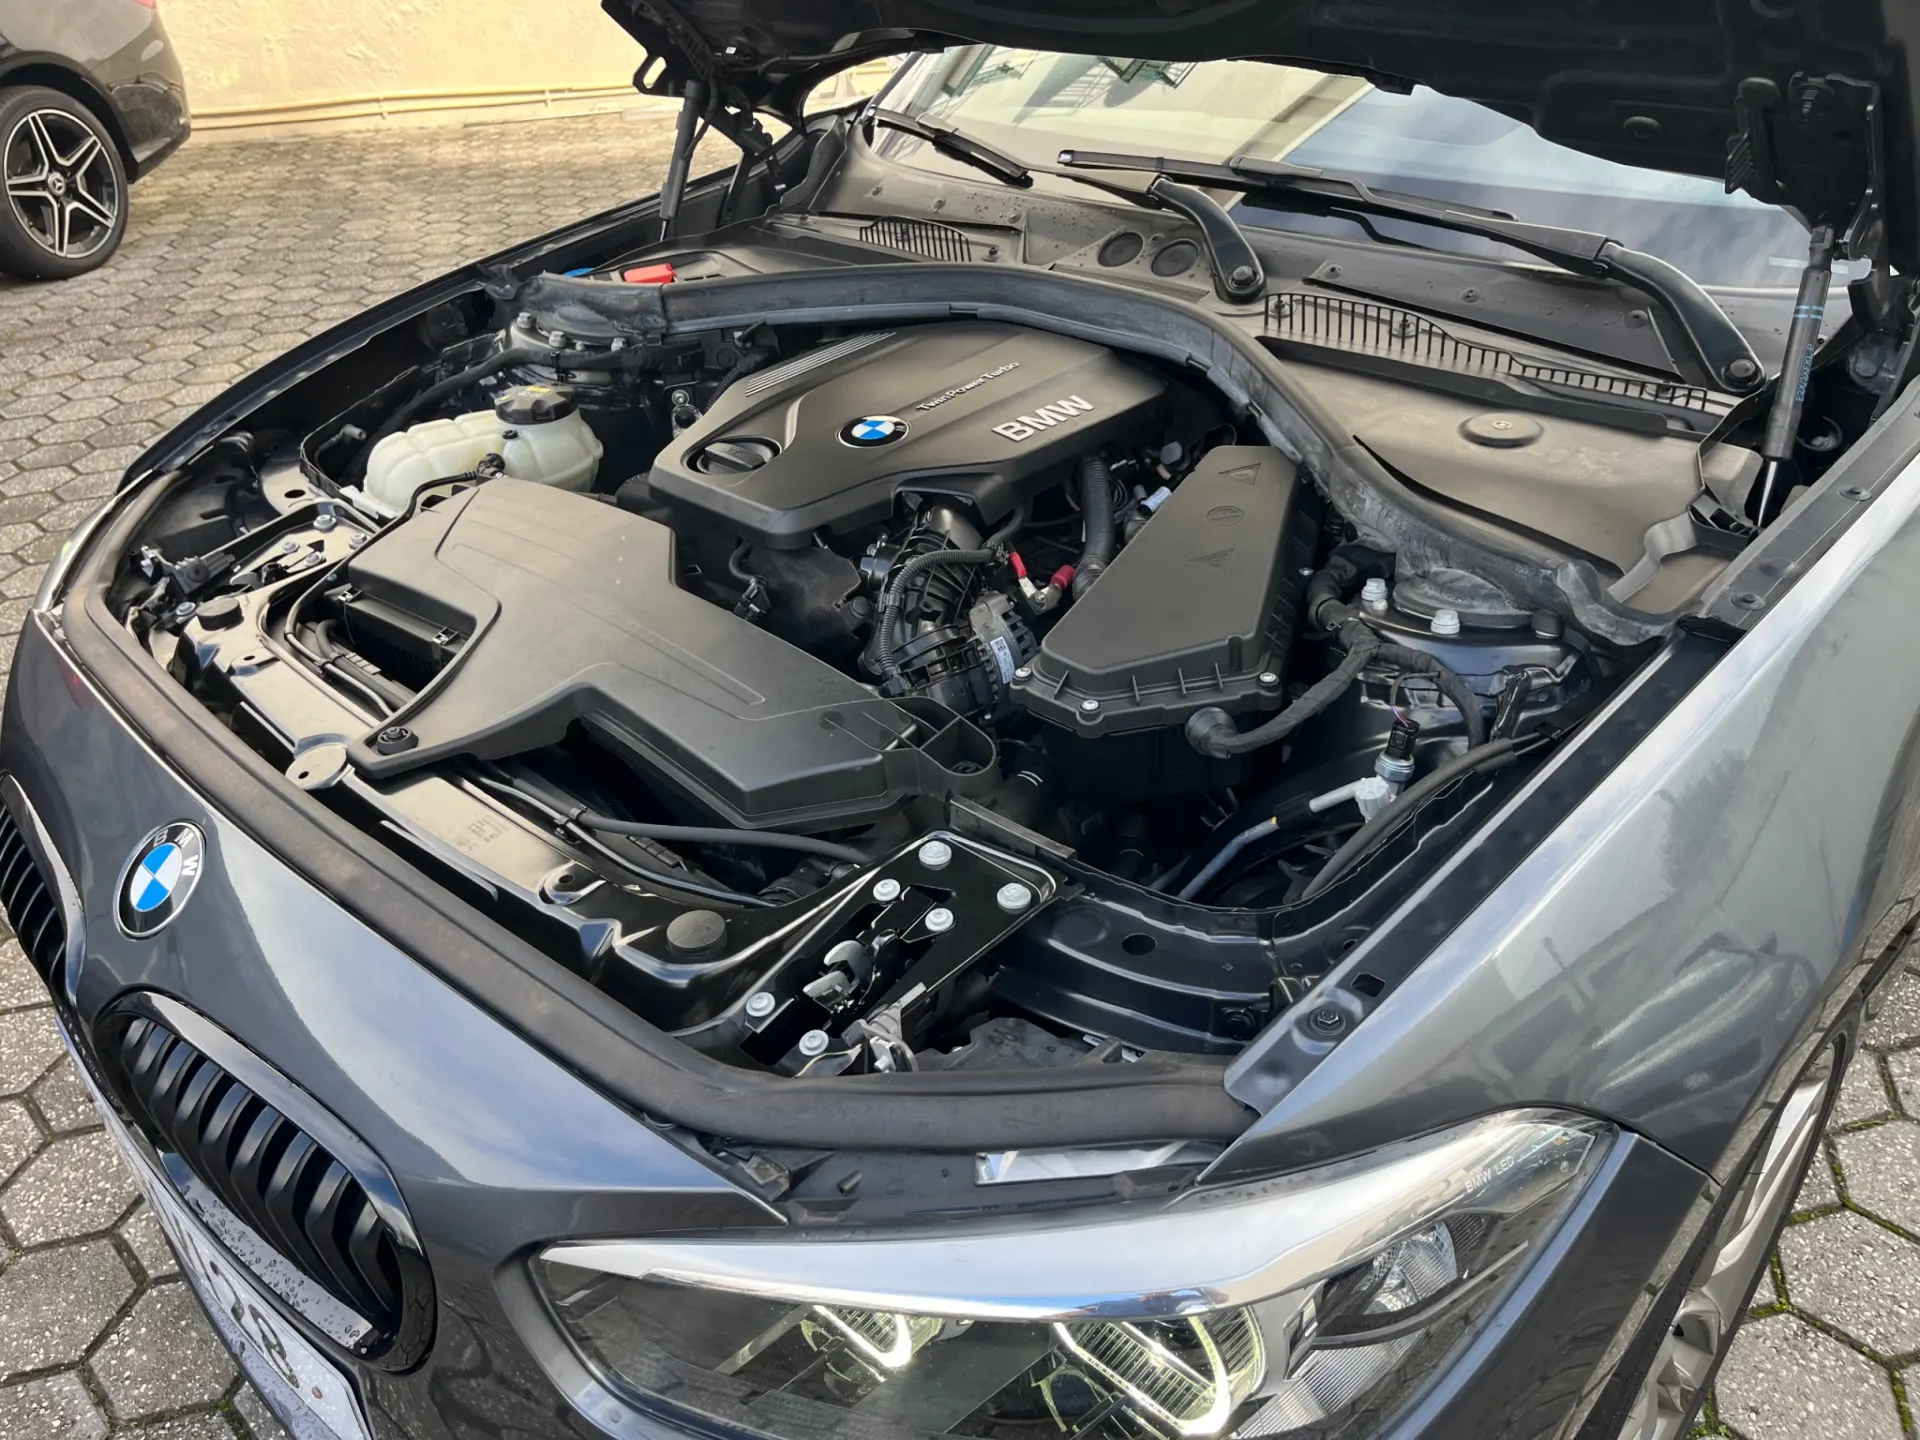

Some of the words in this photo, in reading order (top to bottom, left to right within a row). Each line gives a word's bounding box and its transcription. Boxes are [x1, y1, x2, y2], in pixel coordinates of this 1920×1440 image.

[916, 378, 985, 411] TwinPower
[981, 362, 1020, 380] Turbo
[991, 394, 1095, 443] BMW
[153, 828, 199, 876] BMW
[1465, 1168, 1492, 1193] BMW
[1494, 1155, 1515, 1175] LED
